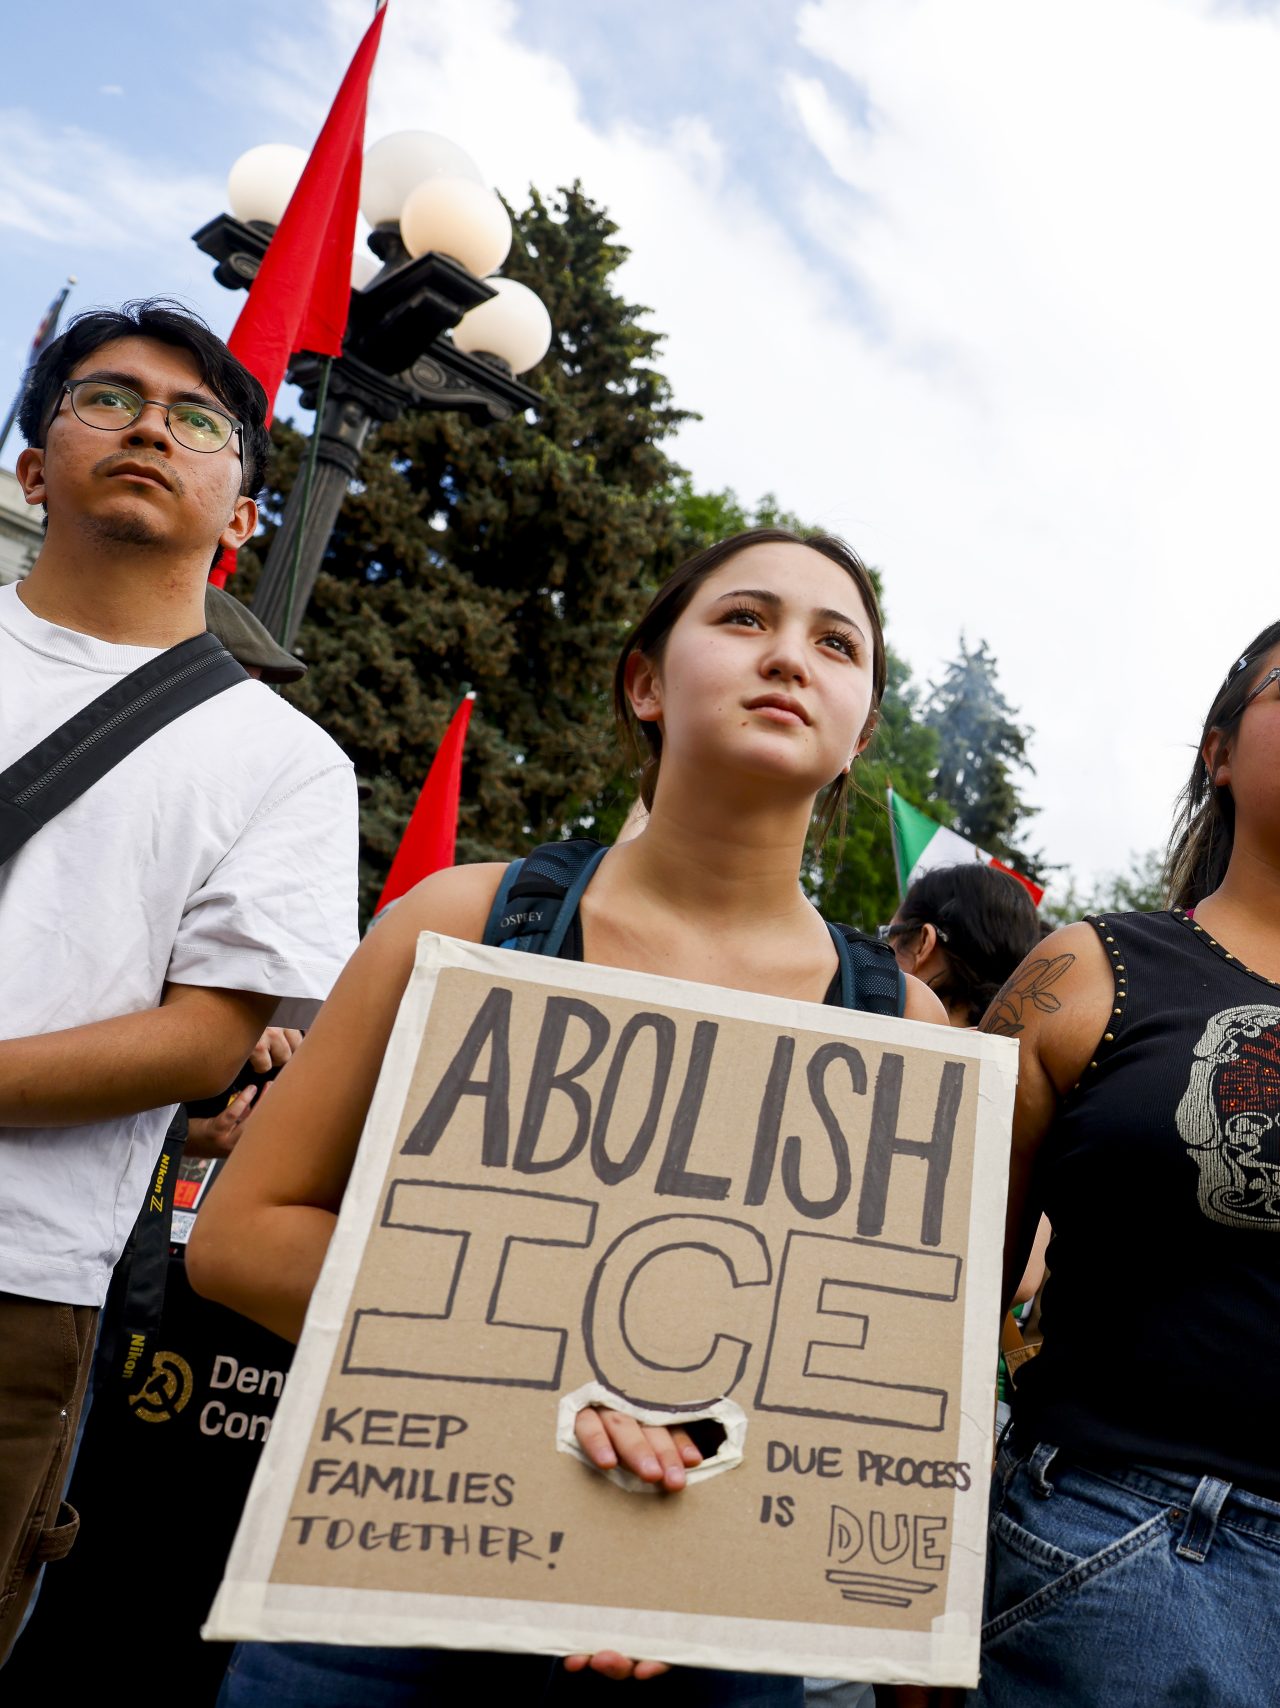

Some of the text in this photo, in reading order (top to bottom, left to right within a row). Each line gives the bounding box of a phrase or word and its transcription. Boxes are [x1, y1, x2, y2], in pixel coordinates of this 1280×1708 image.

[399, 987, 967, 1246] ABOLISH
[154, 1153, 171, 1194] Nikon
[341, 1178, 964, 1432] ICE
[121, 1333, 146, 1379] Nikon
[209, 1354, 288, 1397] Den
[320, 1405, 470, 1449] KEEP
[307, 1458, 516, 1507] FAMILIES
[767, 1440, 973, 1493] DUE PROCESS
[290, 1514, 565, 1570] TOGETHER!
[760, 1495, 949, 1572] IS DUE
